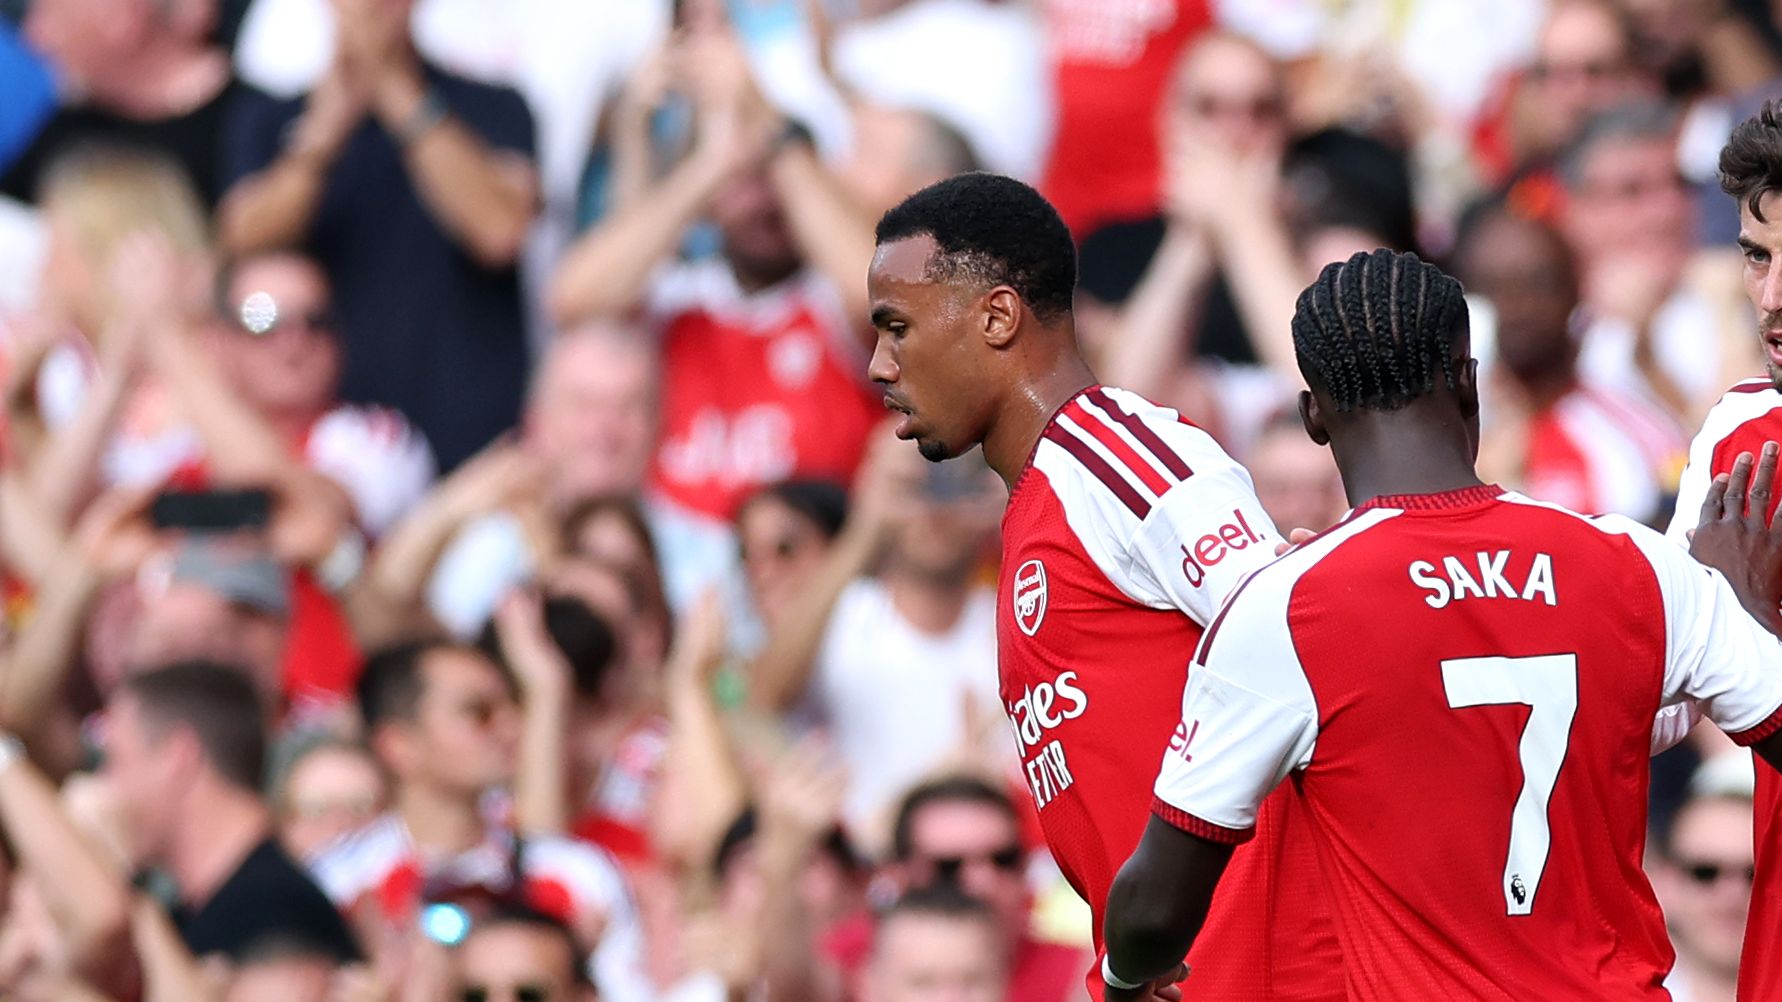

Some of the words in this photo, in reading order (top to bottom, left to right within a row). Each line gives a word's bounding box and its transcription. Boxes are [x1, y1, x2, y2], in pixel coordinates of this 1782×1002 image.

[1181, 508, 1266, 589] deel.
[1409, 549, 1557, 609] SAKA
[1440, 652, 1579, 917] 7
